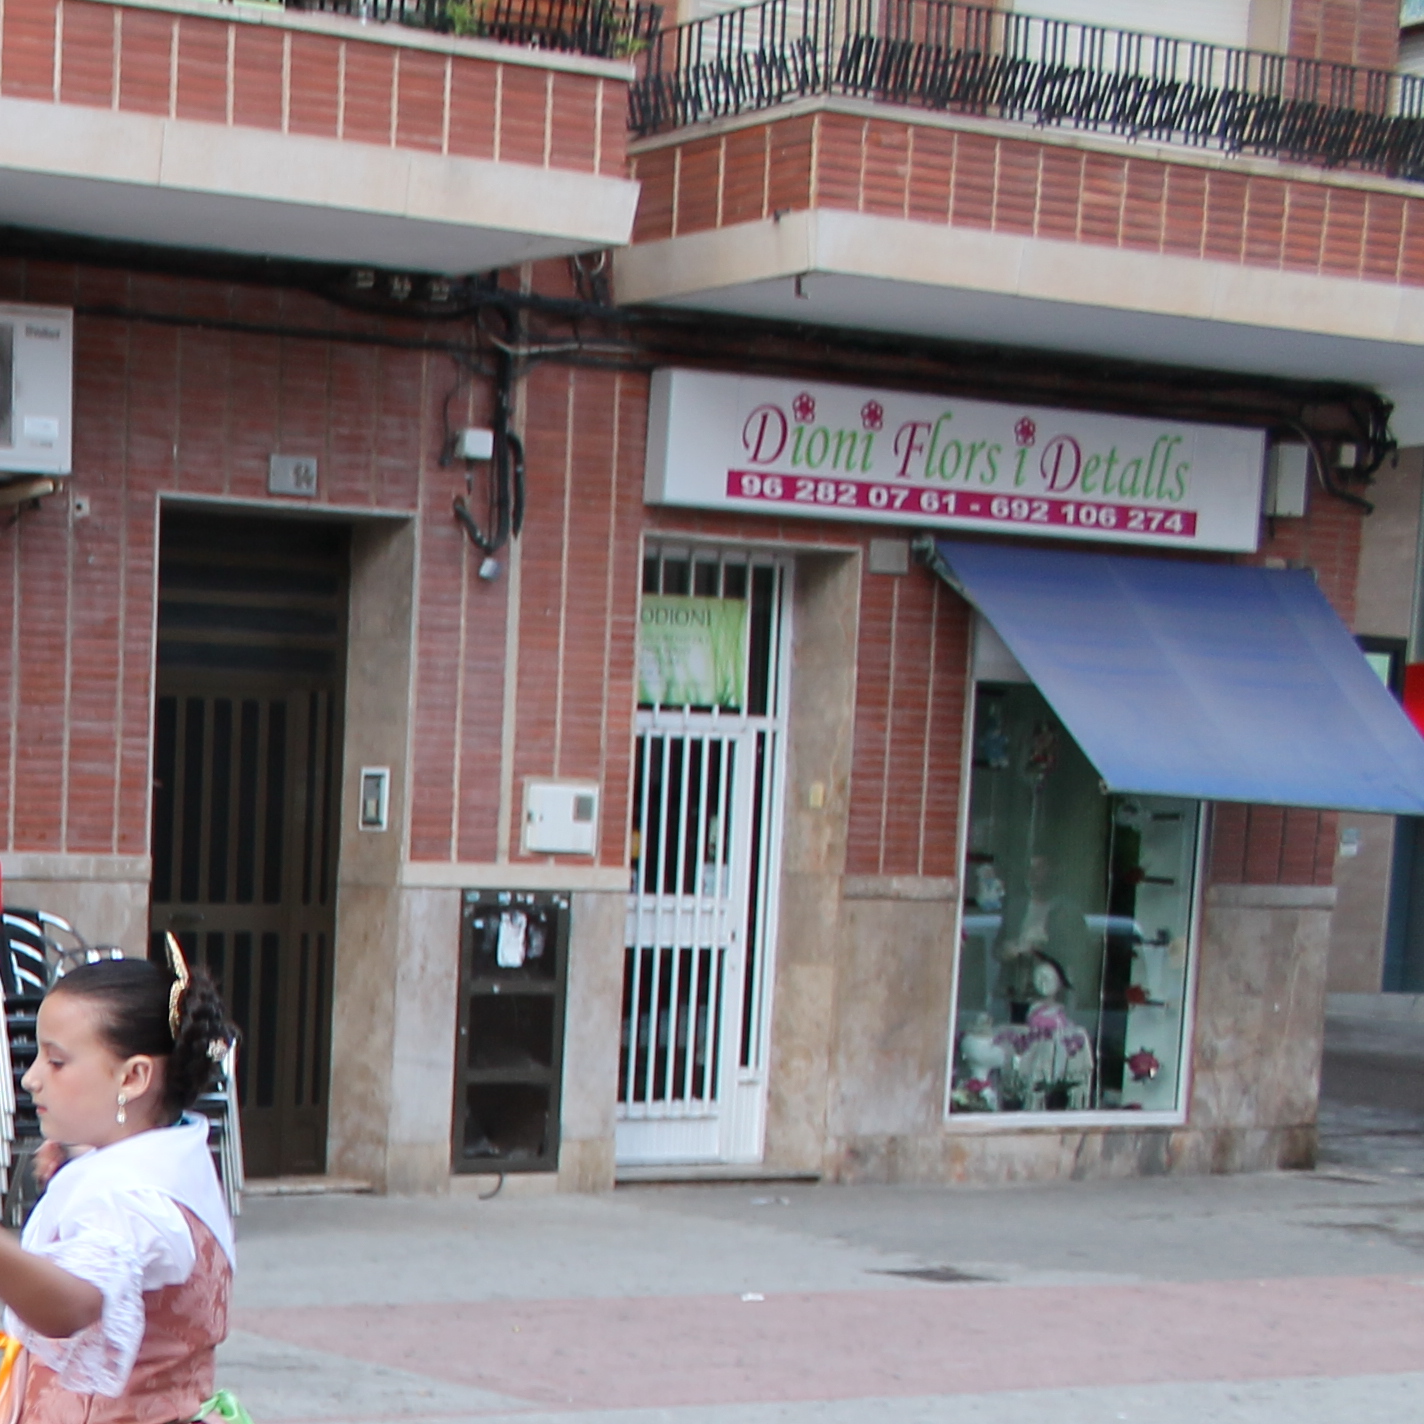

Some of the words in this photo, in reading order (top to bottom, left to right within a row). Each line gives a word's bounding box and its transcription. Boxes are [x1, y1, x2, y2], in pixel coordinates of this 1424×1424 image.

[742, 392, 883, 474] Dioni
[894, 411, 1003, 485] Flors
[1040, 434, 1191, 502] Detalls
[740, 474, 783, 499] 96
[795, 479, 857, 506] 282
[868, 486, 909, 510] 07
[920, 490, 957, 514] 61
[990, 496, 1049, 522] 692
[1061, 502, 1117, 529] 106
[1127, 508, 1184, 534] 274
